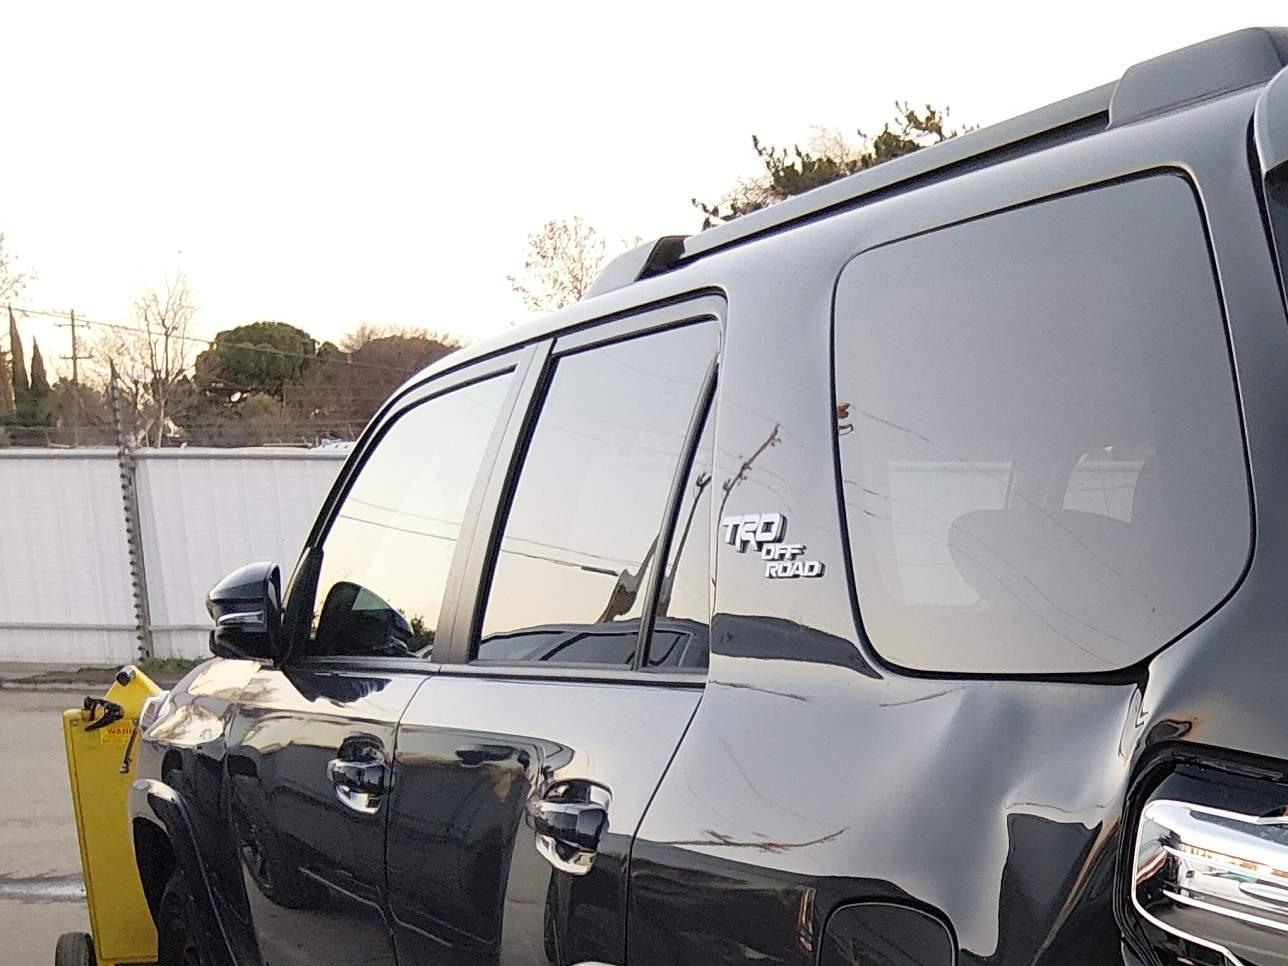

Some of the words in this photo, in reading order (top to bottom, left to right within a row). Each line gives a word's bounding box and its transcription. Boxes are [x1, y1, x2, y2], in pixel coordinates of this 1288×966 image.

[723, 513, 787, 553] TRD
[761, 544, 807, 561] OFF
[765, 561, 825, 579] ROAD
